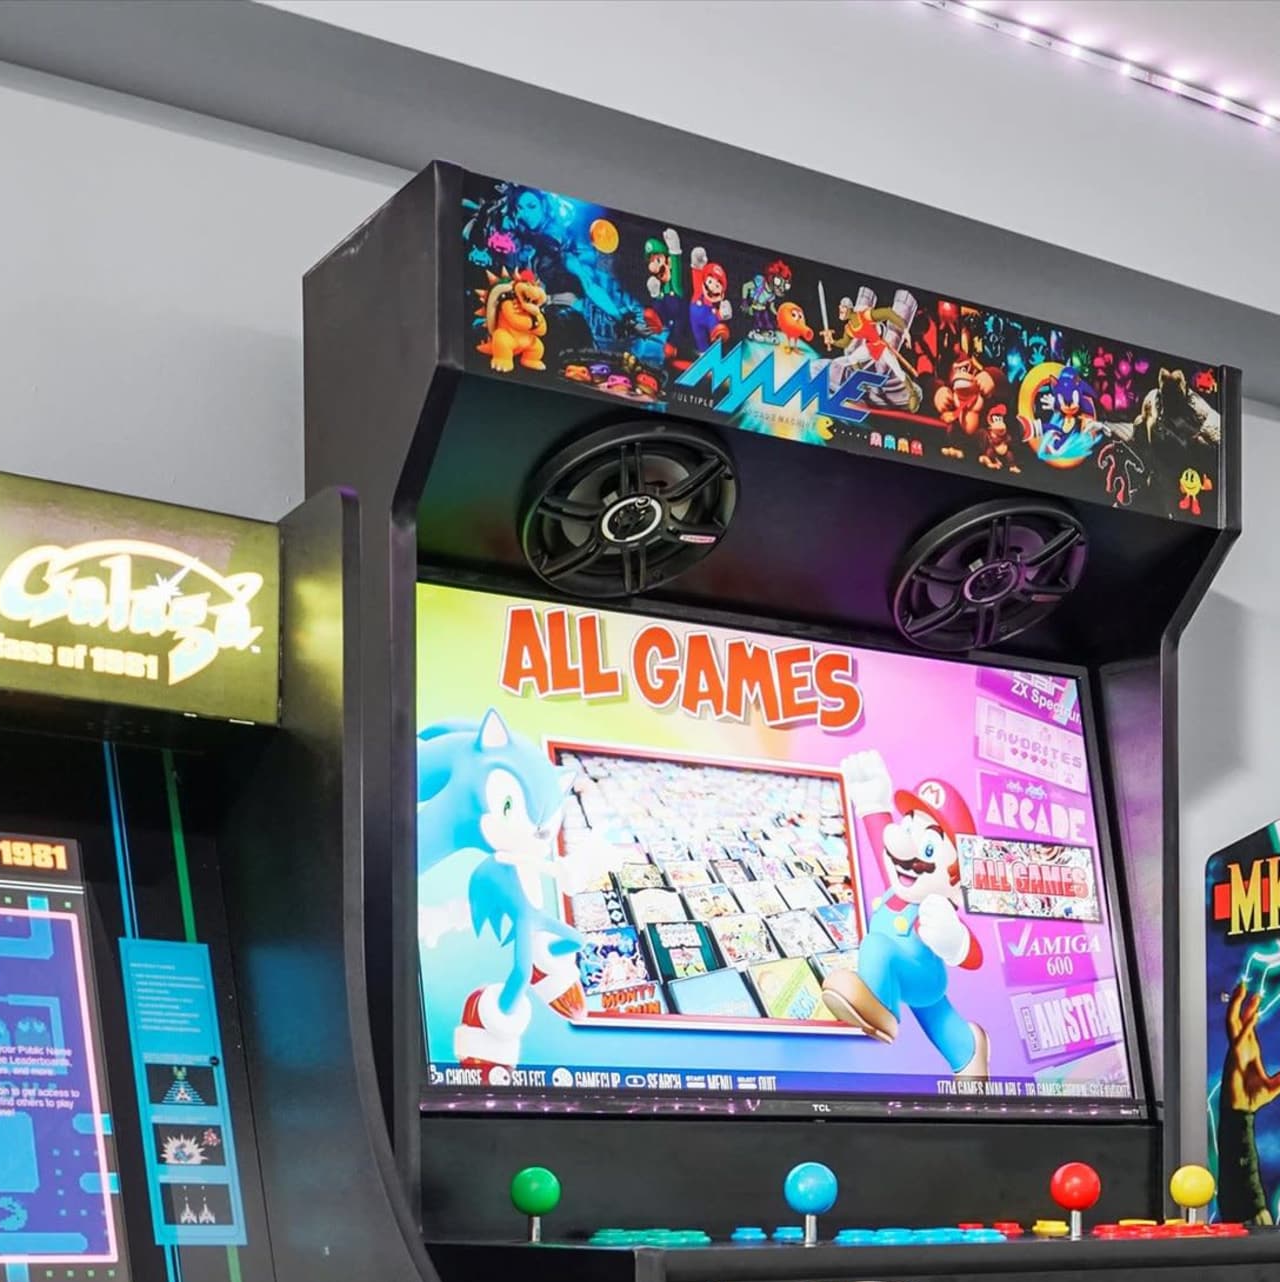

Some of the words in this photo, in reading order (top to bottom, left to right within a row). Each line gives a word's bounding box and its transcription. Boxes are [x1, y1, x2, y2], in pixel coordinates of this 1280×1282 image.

[675, 339, 889, 423] MAME
[57, 644, 89, 669] of
[501, 605, 621, 698] ALL
[632, 626, 863, 731] GAMES
[1011, 680, 1028, 698] ZX
[984, 725, 1083, 769] FAVORITES
[985, 791, 1089, 845] ARCADE
[972, 858, 1012, 893] ALL
[1012, 861, 1091, 898] GAMES
[1026, 934, 1103, 957] AMIGA
[1046, 956, 1074, 976] 600
[16, 1098, 45, 1107] others
[46, 1099, 55, 1108] to
[56, 1100, 74, 1110] play
[71, 1090, 80, 1098] to
[812, 1104, 831, 1113] TCL
